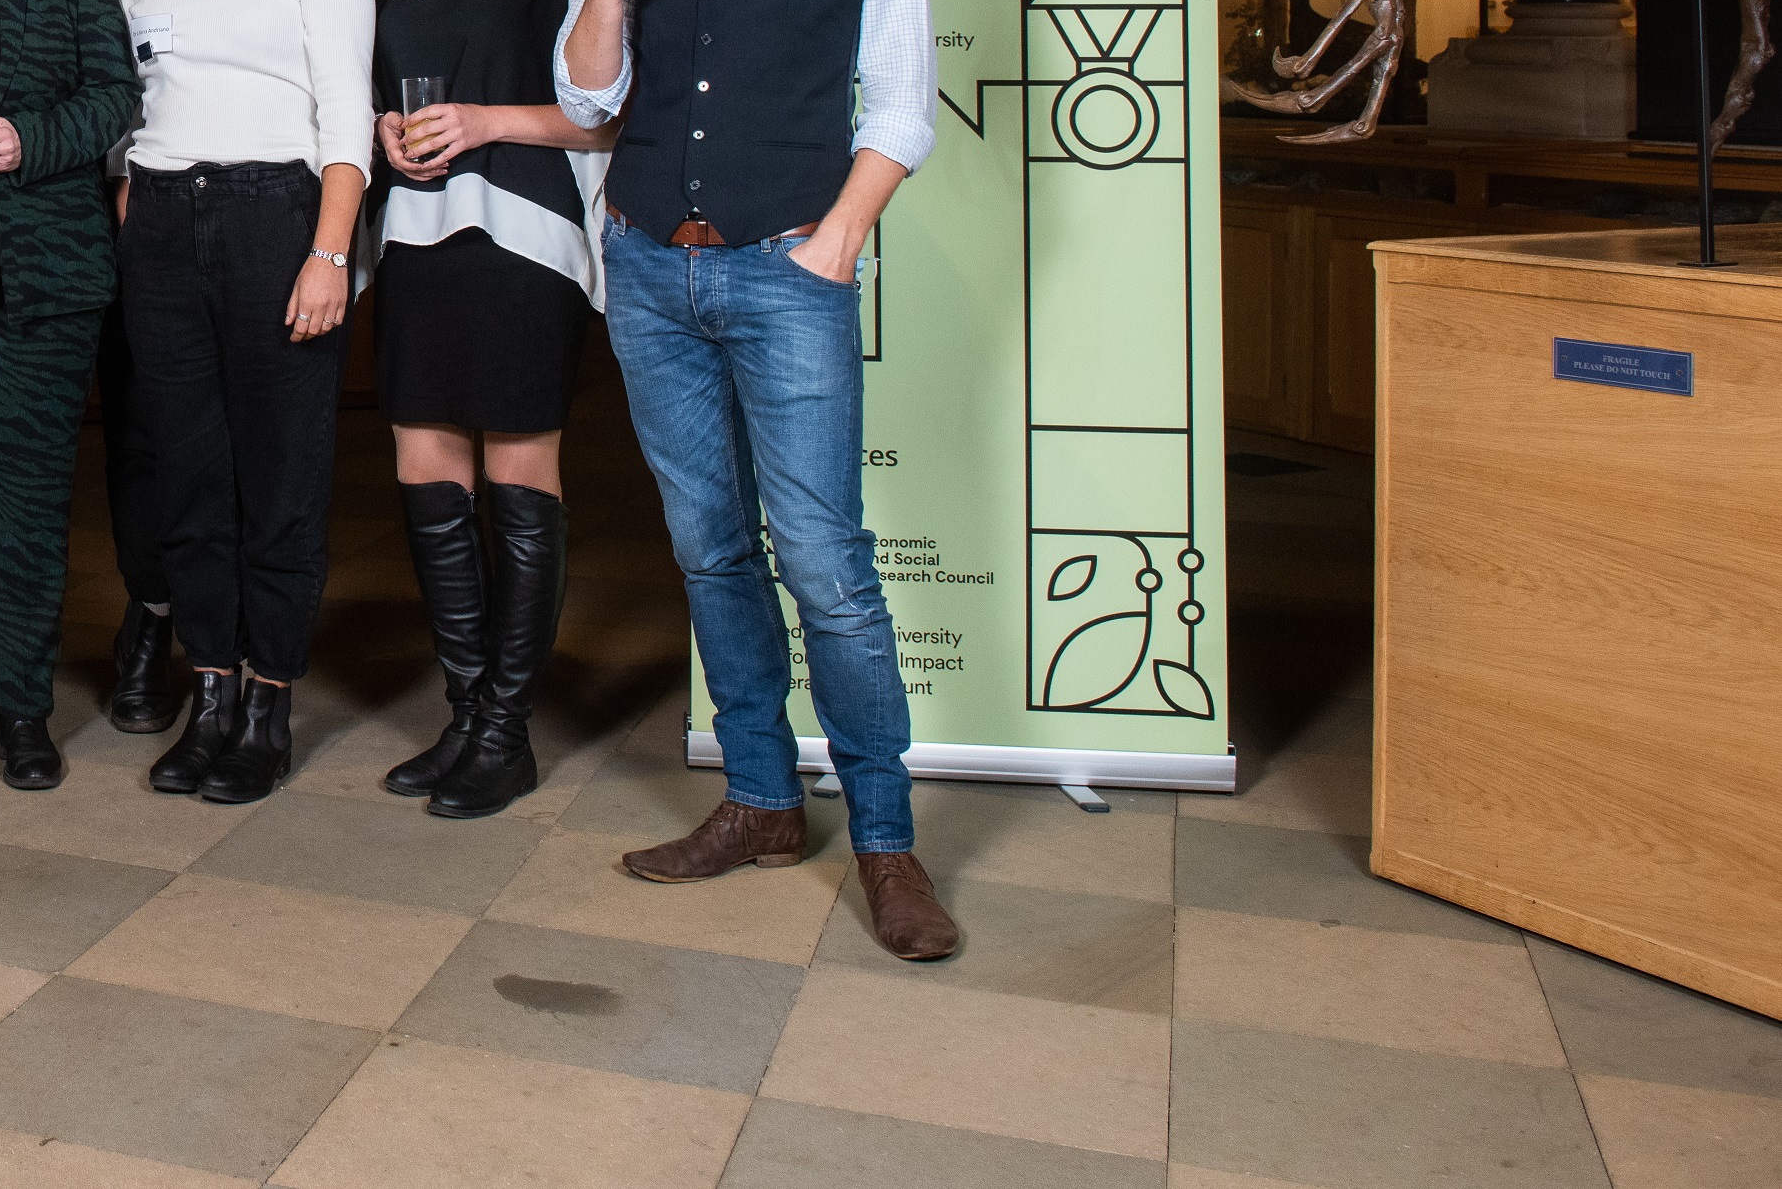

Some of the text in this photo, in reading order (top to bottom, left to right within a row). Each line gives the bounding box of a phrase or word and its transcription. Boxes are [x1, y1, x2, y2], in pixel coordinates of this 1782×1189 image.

[1603, 355, 1640, 366] FRAGILE
[1574, 361, 1604, 372] PLEASE
[1620, 367, 1638, 376] NOT
[1640, 370, 1670, 380] TOUCH
[873, 537, 936, 549] conomic
[874, 552, 939, 565] nd Social
[880, 569, 994, 584] search Council
[894, 627, 962, 648] iversity
[900, 653, 963, 672] Impact
